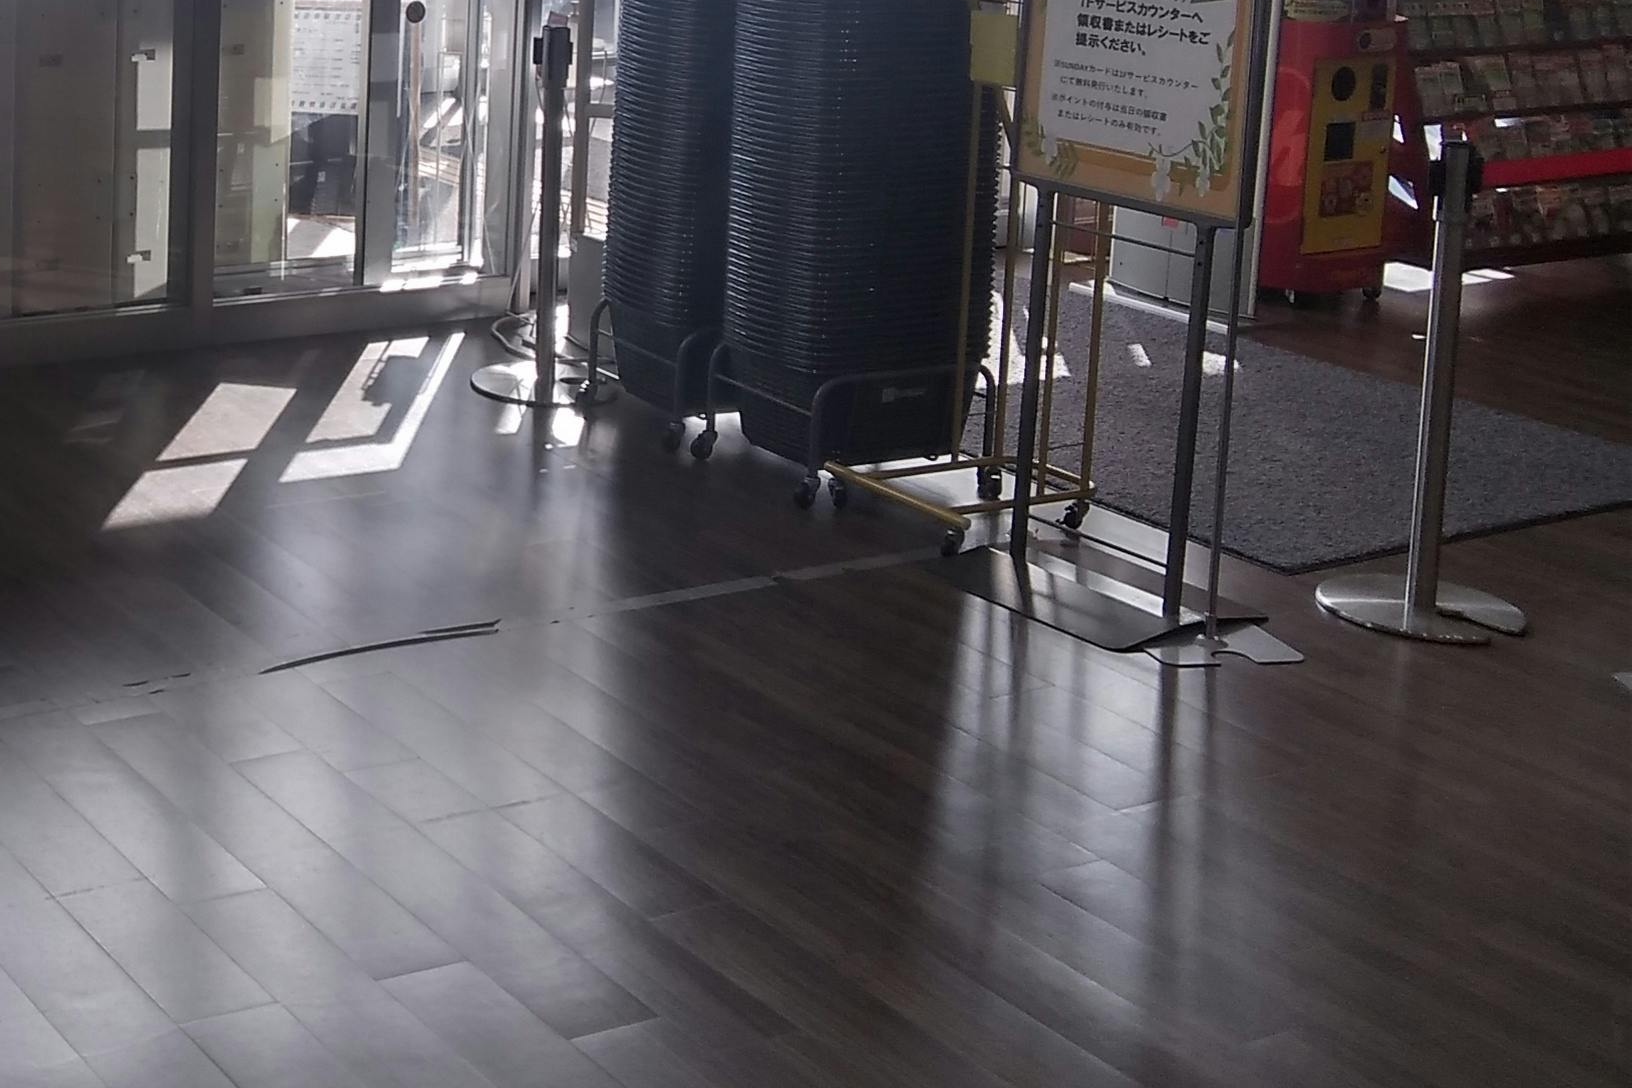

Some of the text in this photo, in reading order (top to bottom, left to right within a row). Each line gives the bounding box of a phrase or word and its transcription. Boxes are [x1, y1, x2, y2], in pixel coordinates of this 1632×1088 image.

[1076, 13, 1211, 45] 領収書またはレシートをご
[1075, 32, 1147, 56] 提示ください。
